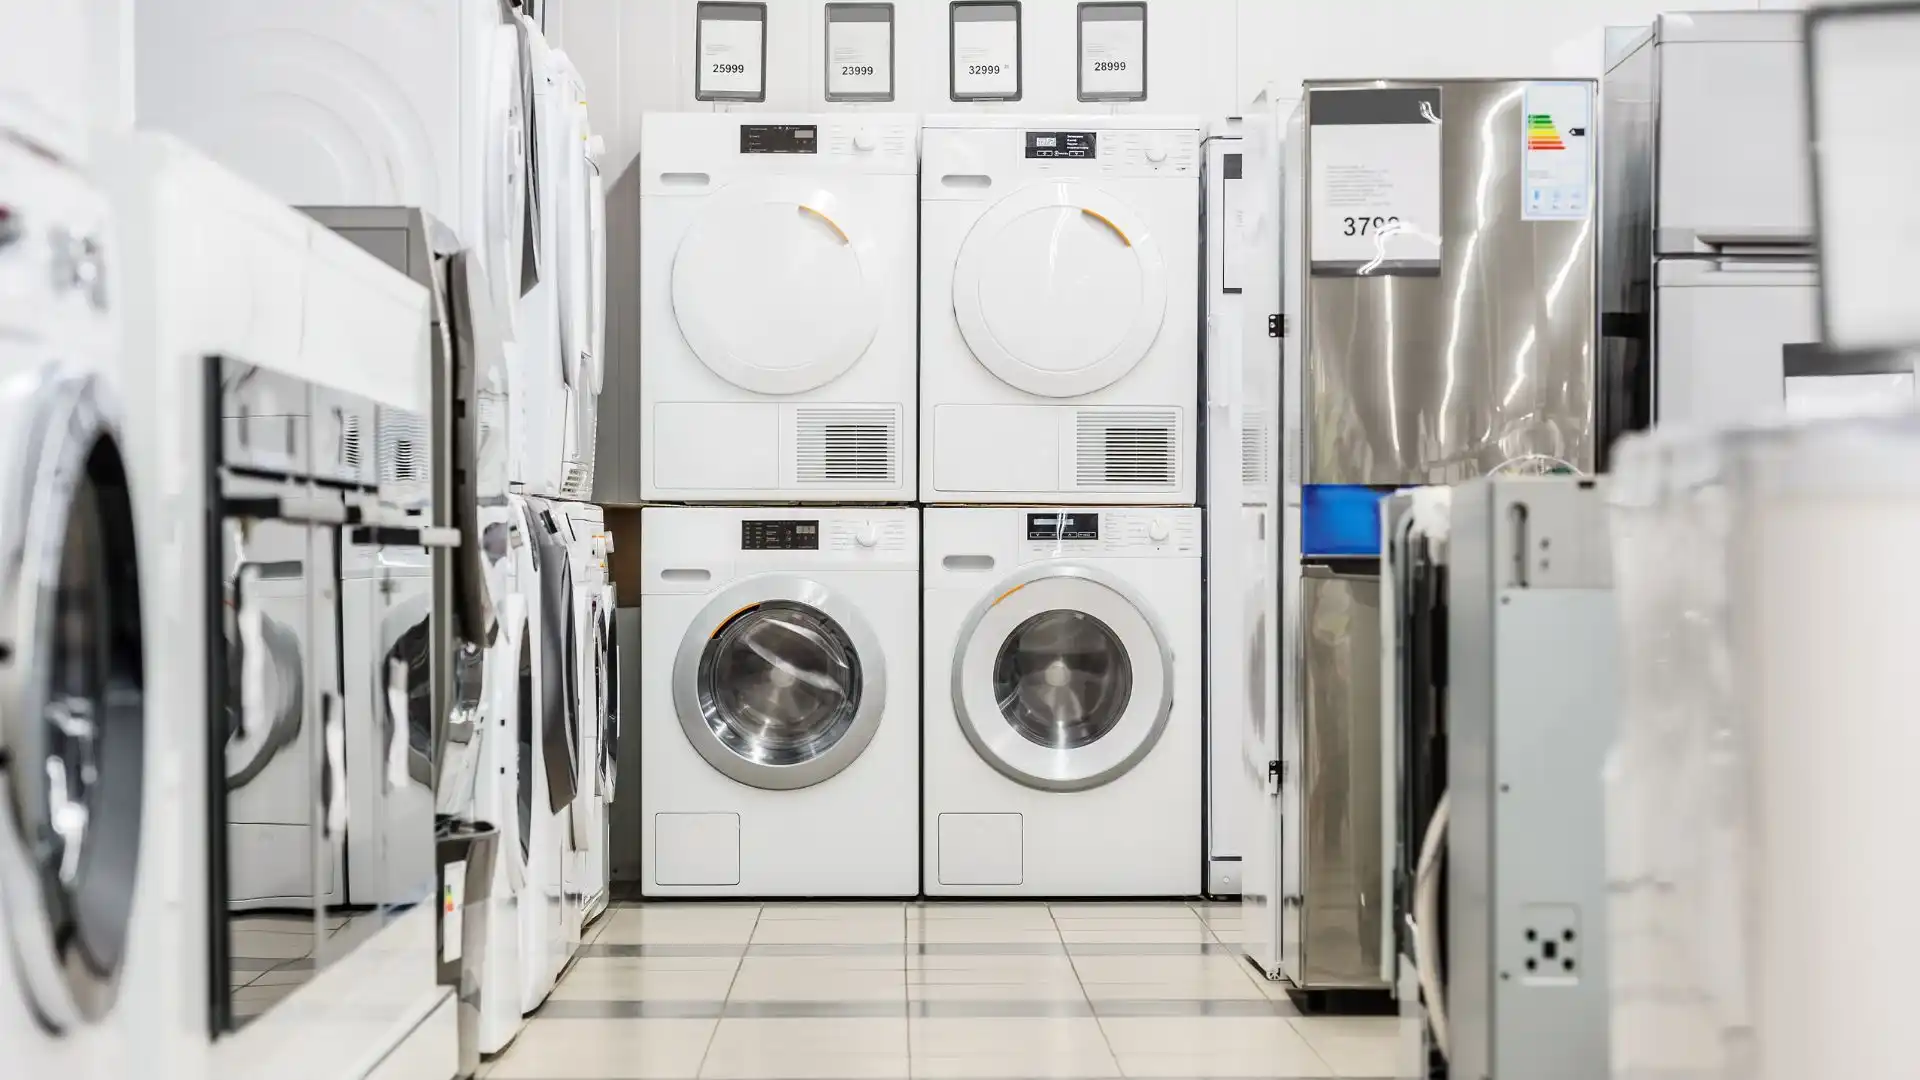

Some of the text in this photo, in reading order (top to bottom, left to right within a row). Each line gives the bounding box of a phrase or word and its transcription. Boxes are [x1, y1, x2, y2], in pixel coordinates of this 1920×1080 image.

[712, 63, 745, 74] 25999
[842, 66, 874, 76] 23999
[968, 65, 1000, 75] 32999
[1094, 61, 1127, 72] 28999
